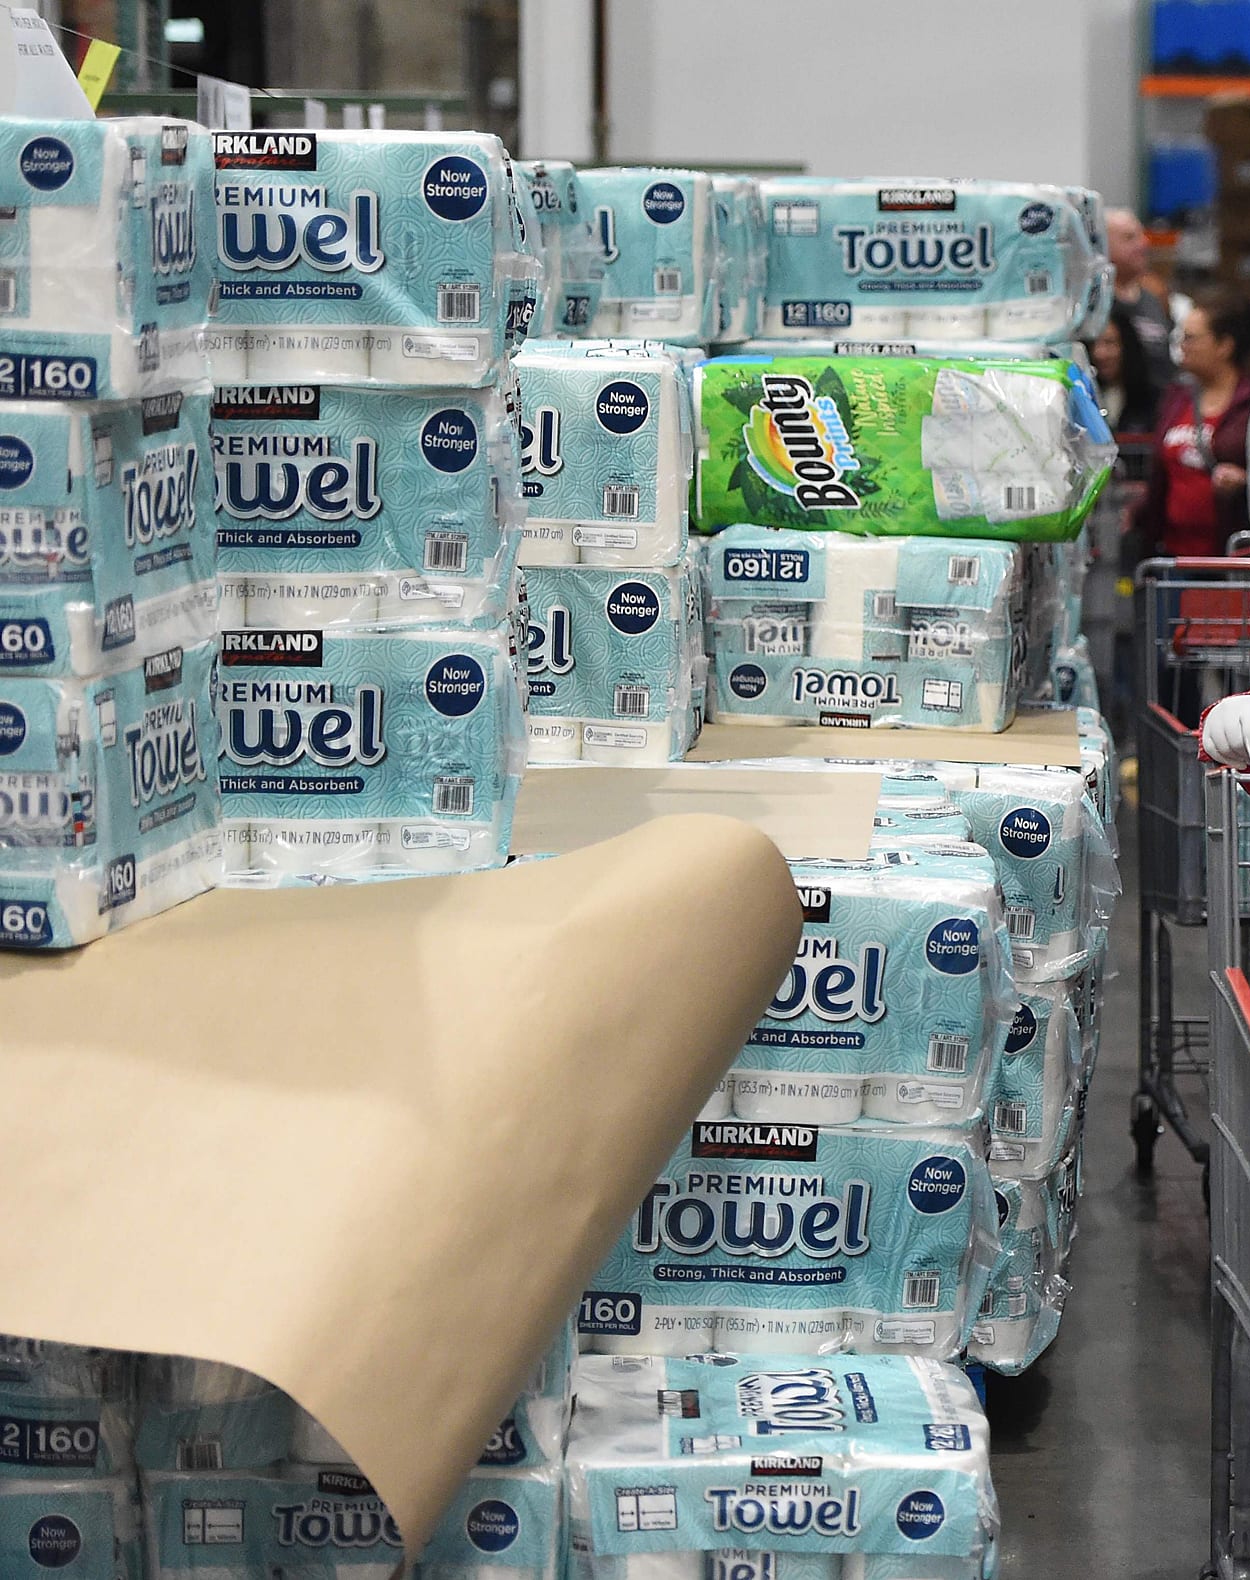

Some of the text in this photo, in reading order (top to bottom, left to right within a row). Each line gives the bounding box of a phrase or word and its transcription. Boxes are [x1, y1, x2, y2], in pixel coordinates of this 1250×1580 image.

[212, 135, 311, 155] IRKLAND
[33, 148, 60, 159] Now
[22, 159, 72, 173] Stronger
[440, 170, 471, 183] Now
[215, 187, 319, 207] EMIUM
[427, 184, 484, 199] Stronger
[652, 190, 675, 200] Now
[880, 189, 955, 205] KIRKLAND
[222, 195, 379, 266] wel
[876, 223, 959, 235] PREMIUM
[838, 227, 991, 269] Towel
[221, 283, 357, 296] hick and Absorbent
[785, 302, 849, 320] 12 160
[286, 336, 294, 350] IN
[304, 337, 308, 350] 7
[310, 337, 320, 350] IN
[0, 359, 92, 389] 2 160
[214, 387, 315, 404] IRKLAND
[610, 392, 634, 403] Now
[599, 403, 646, 417] Stronger
[817, 398, 859, 468] Prints
[214, 436, 322, 456] REMIUM
[424, 435, 476, 451] Stronger
[762, 376, 859, 509] Bounty
[0, 446, 19, 458] ow
[0, 459, 30, 472] onger
[226, 442, 377, 512] wel
[123, 449, 195, 541] Towel
[218, 532, 356, 545] Thick and Absorbent
[728, 558, 804, 579] 12 160
[621, 592, 646, 604] Now
[609, 603, 657, 616] Stronger
[1, 624, 46, 652] 60
[222, 634, 318, 652] IRKLAND
[443, 667, 470, 681] Now
[222, 682, 322, 703] REMIUM
[428, 680, 482, 694] Stronger
[793, 670, 900, 703] Towel
[814, 697, 875, 709] PREMIUM
[0, 713, 15, 725] ow
[145, 705, 182, 732] PREMIU
[229, 689, 379, 758] wel
[821, 715, 870, 728] KIRKLAND
[0, 725, 25, 738] nger
[125, 703, 205, 802] Towel
[222, 778, 358, 791] Thick and Absorbent
[1014, 816, 1039, 831] Now
[1002, 827, 1048, 844] Stronger
[111, 862, 133, 889] 160
[1, 904, 46, 933] 60
[943, 930, 971, 942] Now
[928, 941, 979, 956] Stronge
[756, 1032, 860, 1046] and Absorbent
[700, 1126, 813, 1147] KIRKLAND
[924, 1167, 952, 1180] Now
[688, 1175, 820, 1196] PREMIUM
[911, 1180, 963, 1194] Stronger
[637, 1184, 868, 1249] Towel
[658, 1266, 843, 1282] Strong, Thick and Absorbent
[581, 1296, 636, 1322] 160
[604, 1322, 618, 1331] PER
[619, 1323, 635, 1331] ROLL
[654, 1317, 676, 1330] 2-PLY
[714, 1318, 724, 1331] FT
[774, 1318, 784, 1332] IN
[792, 1319, 798, 1332] 7
[2, 1423, 96, 1453] 2 160
[754, 1458, 820, 1471] KIRKLAND
[322, 1474, 367, 1491] KIRKLA
[745, 1484, 824, 1496] PREMIUM
[615, 1486, 676, 1497] Create-A-Size
[707, 1489, 858, 1532] Towel
[910, 1501, 934, 1512] Now
[275, 1505, 401, 1543] Towe
[482, 1511, 506, 1522] Now
[898, 1511, 943, 1525] Stronger
[41, 1527, 66, 1539] Now
[468, 1521, 516, 1534] Stronger
[31, 1538, 78, 1551] Stronger
